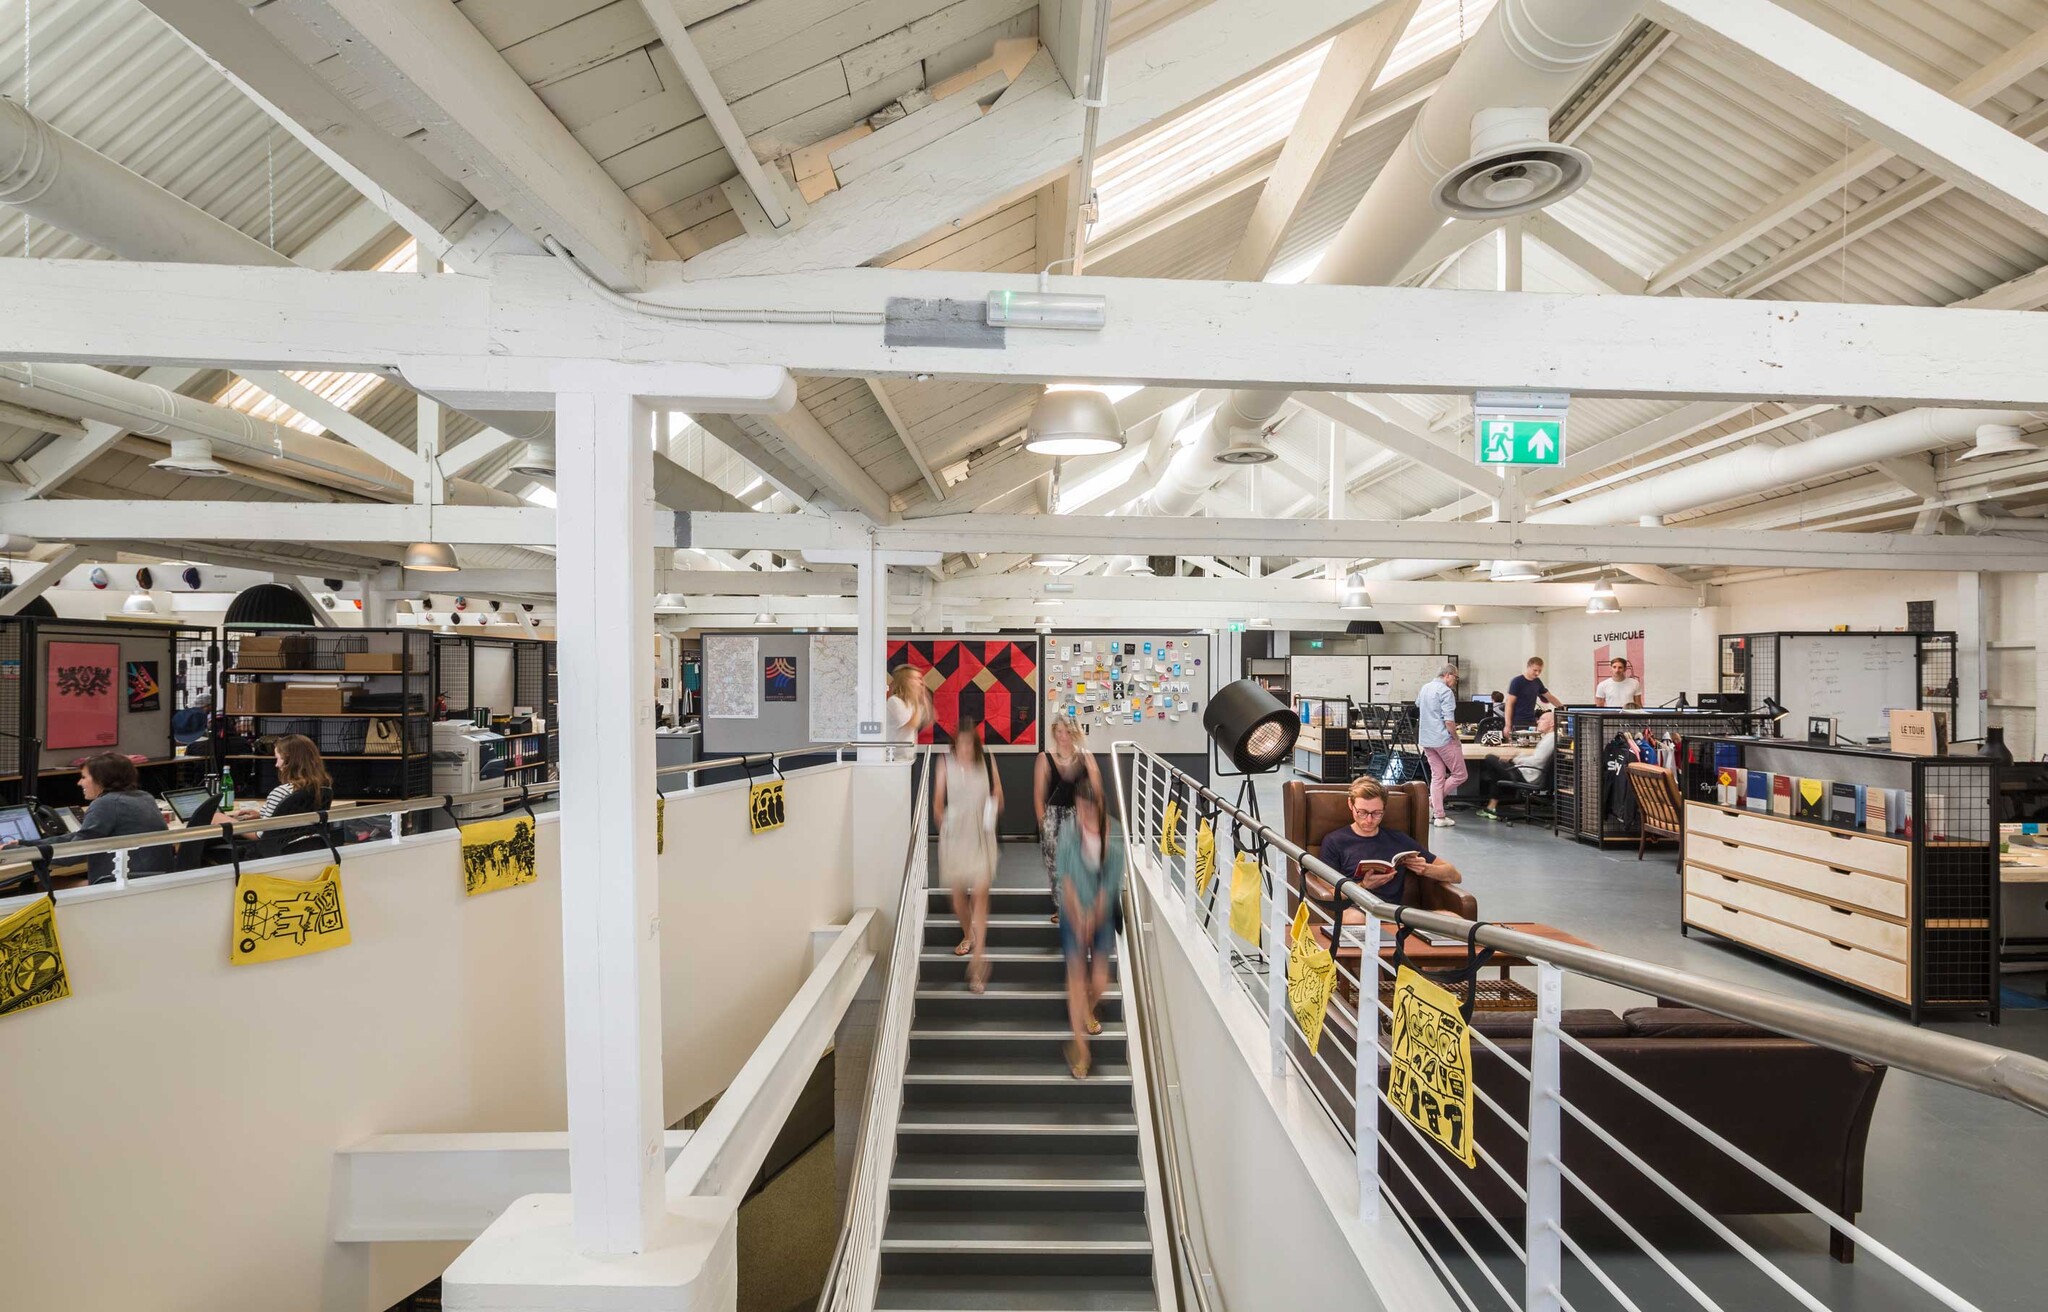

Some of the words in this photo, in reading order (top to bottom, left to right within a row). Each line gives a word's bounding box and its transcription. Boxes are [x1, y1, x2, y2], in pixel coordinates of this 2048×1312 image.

[1593, 634, 1602, 643] LE
[1901, 725, 1908, 735] LE
[1908, 725, 1925, 736] TOUR
